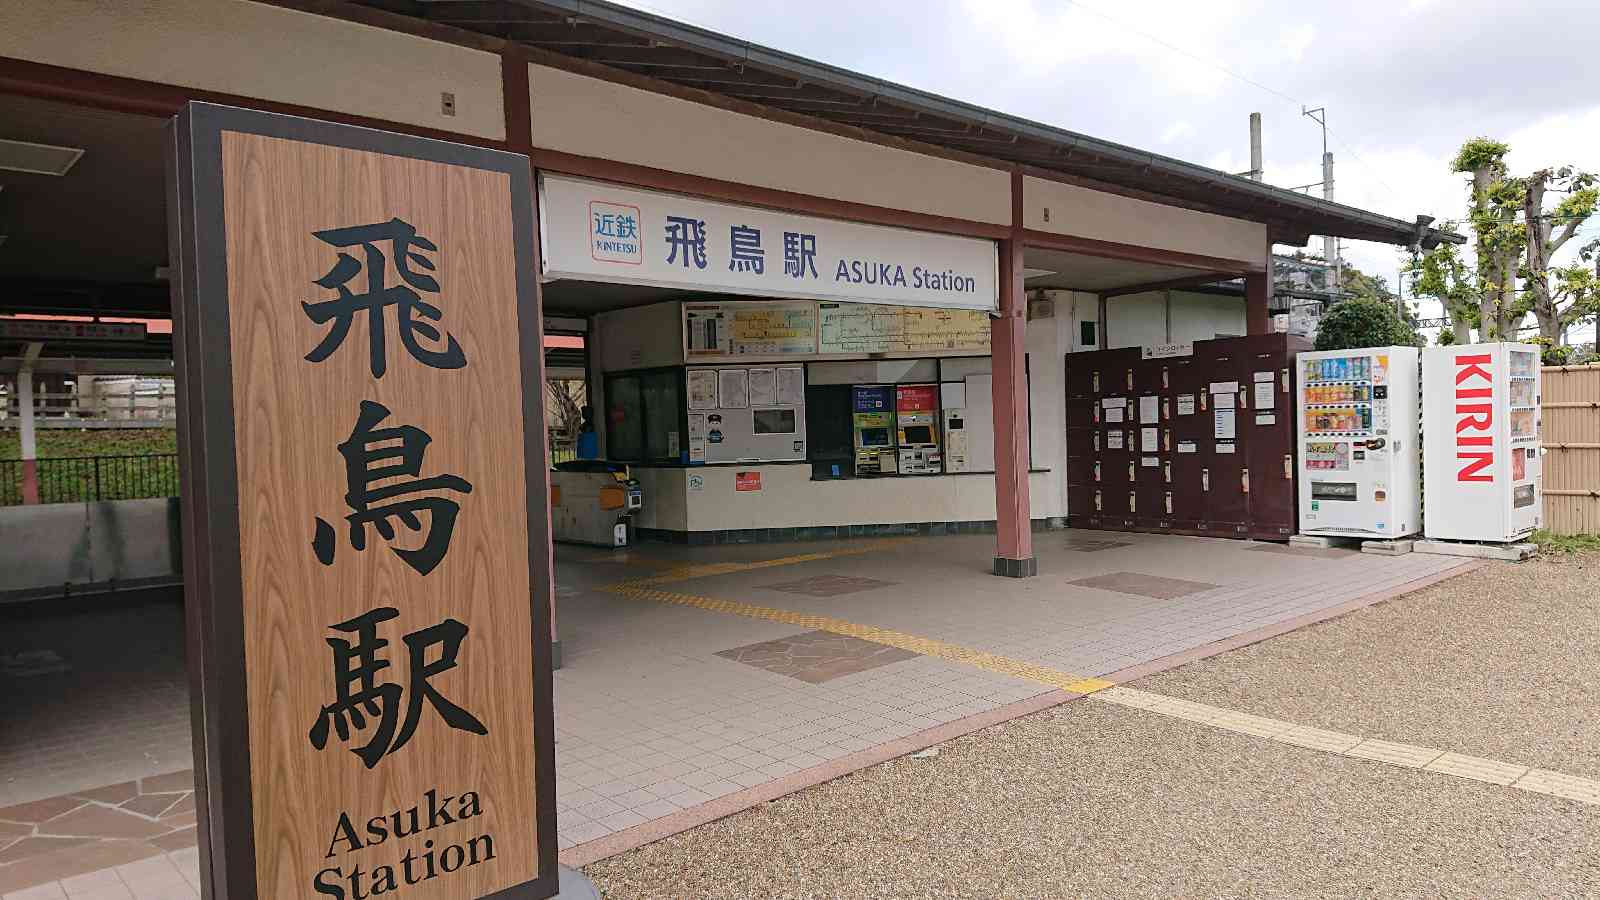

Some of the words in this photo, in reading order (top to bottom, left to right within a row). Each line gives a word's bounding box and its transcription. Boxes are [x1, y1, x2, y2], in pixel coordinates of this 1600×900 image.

[593, 212, 637, 239] 近鉄
[596, 240, 638, 254] KINTETSU
[665, 215, 819, 279] 飛鳥駅
[834, 259, 907, 287] ASUKA
[912, 266, 976, 293] Station
[1455, 352, 1494, 482] KIRIN
[301, 216, 489, 770] 飛鳥駅
[325, 788, 484, 858] Asuka
[313, 832, 497, 900] Station
